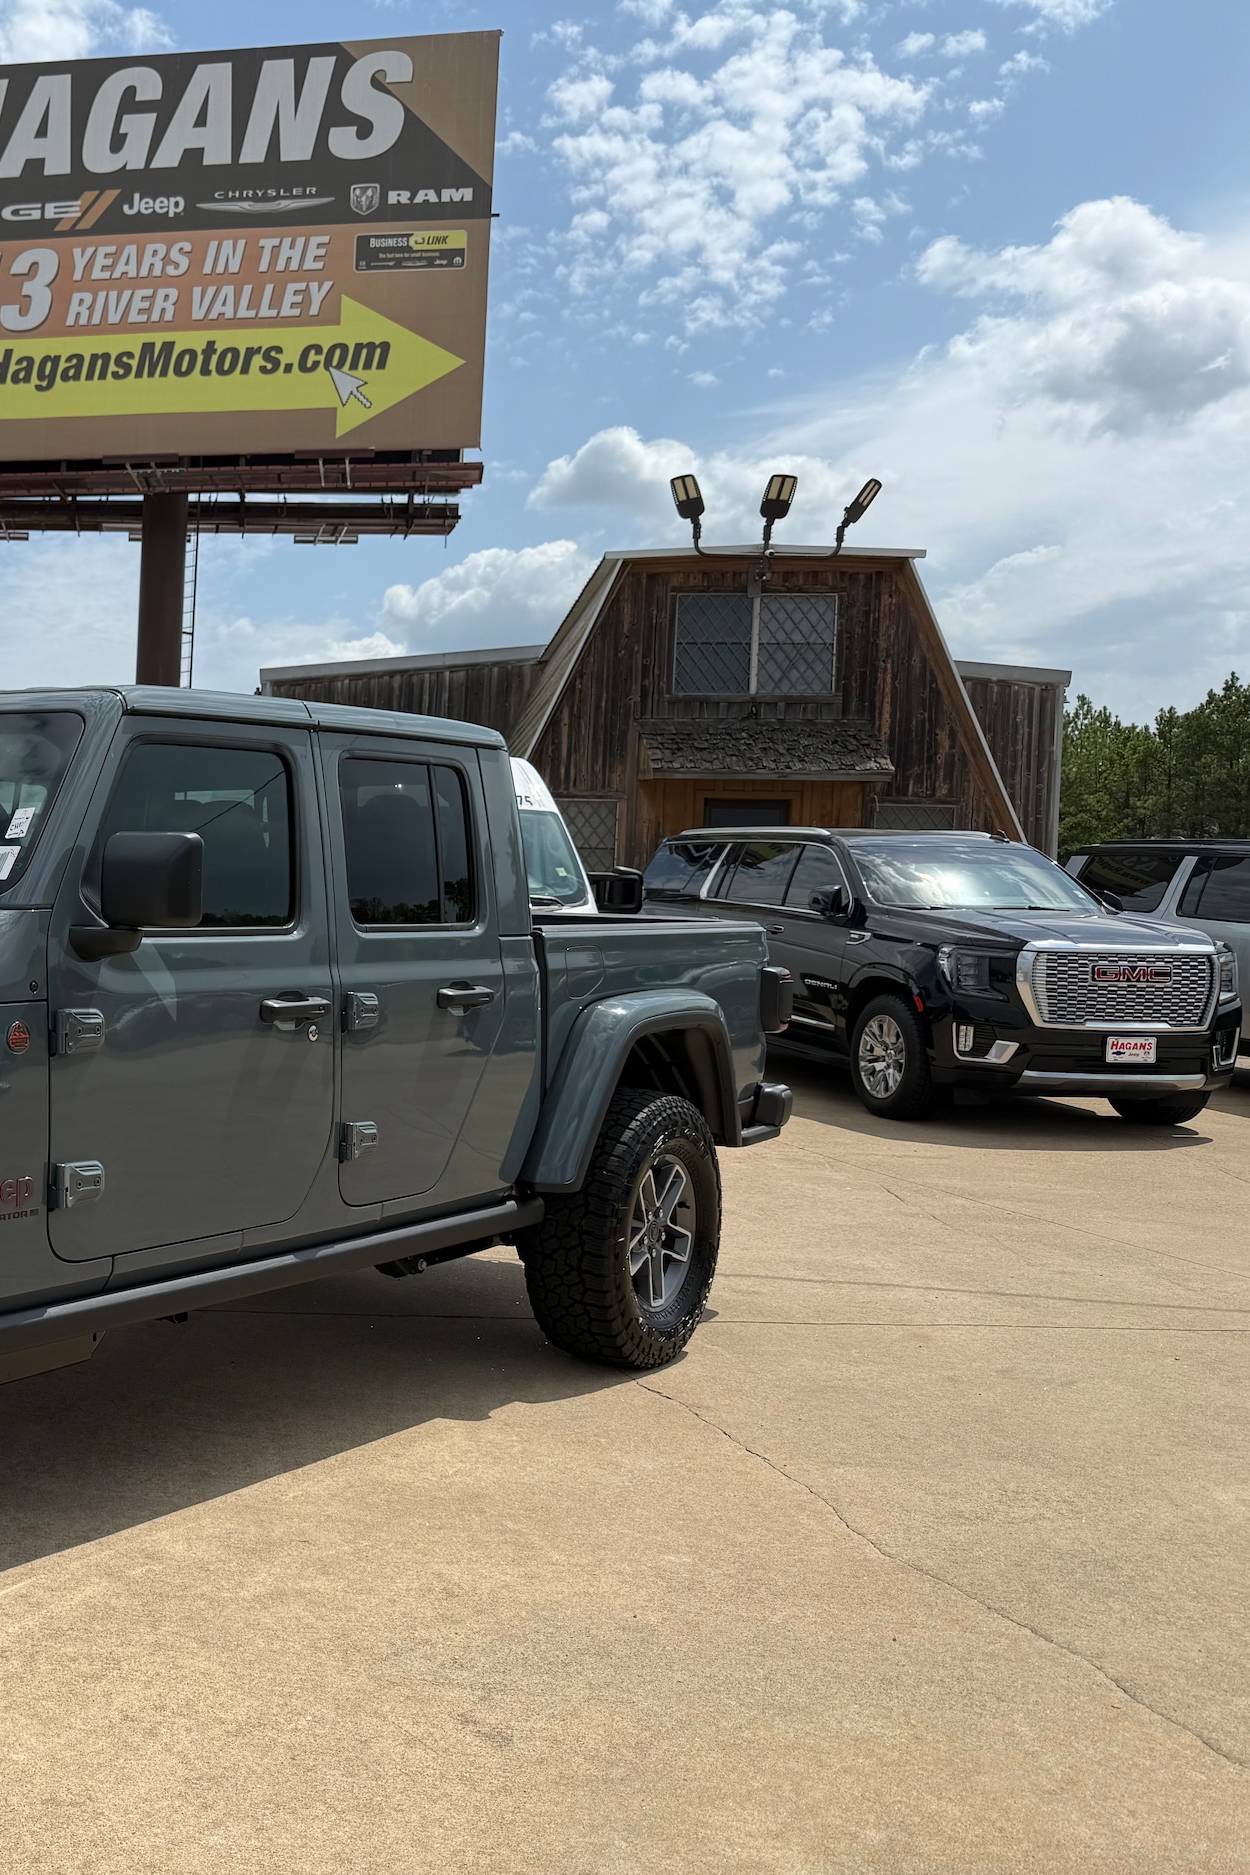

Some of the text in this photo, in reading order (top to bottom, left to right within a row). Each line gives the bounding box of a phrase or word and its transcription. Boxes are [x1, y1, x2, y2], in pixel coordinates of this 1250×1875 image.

[213, 186, 318, 199] CHRYSLER
[387, 187, 474, 205] RAM
[122, 192, 185, 218] Jeep
[369, 235, 449, 248] BUSINESS LINK
[72, 235, 332, 282] YEARS IN THE
[65, 280, 334, 327] RIVER VALLEY
[1094, 965, 1171, 983] GMC
[804, 978, 838, 990] DENALI
[1110, 1039, 1153, 1051] HAGANS
